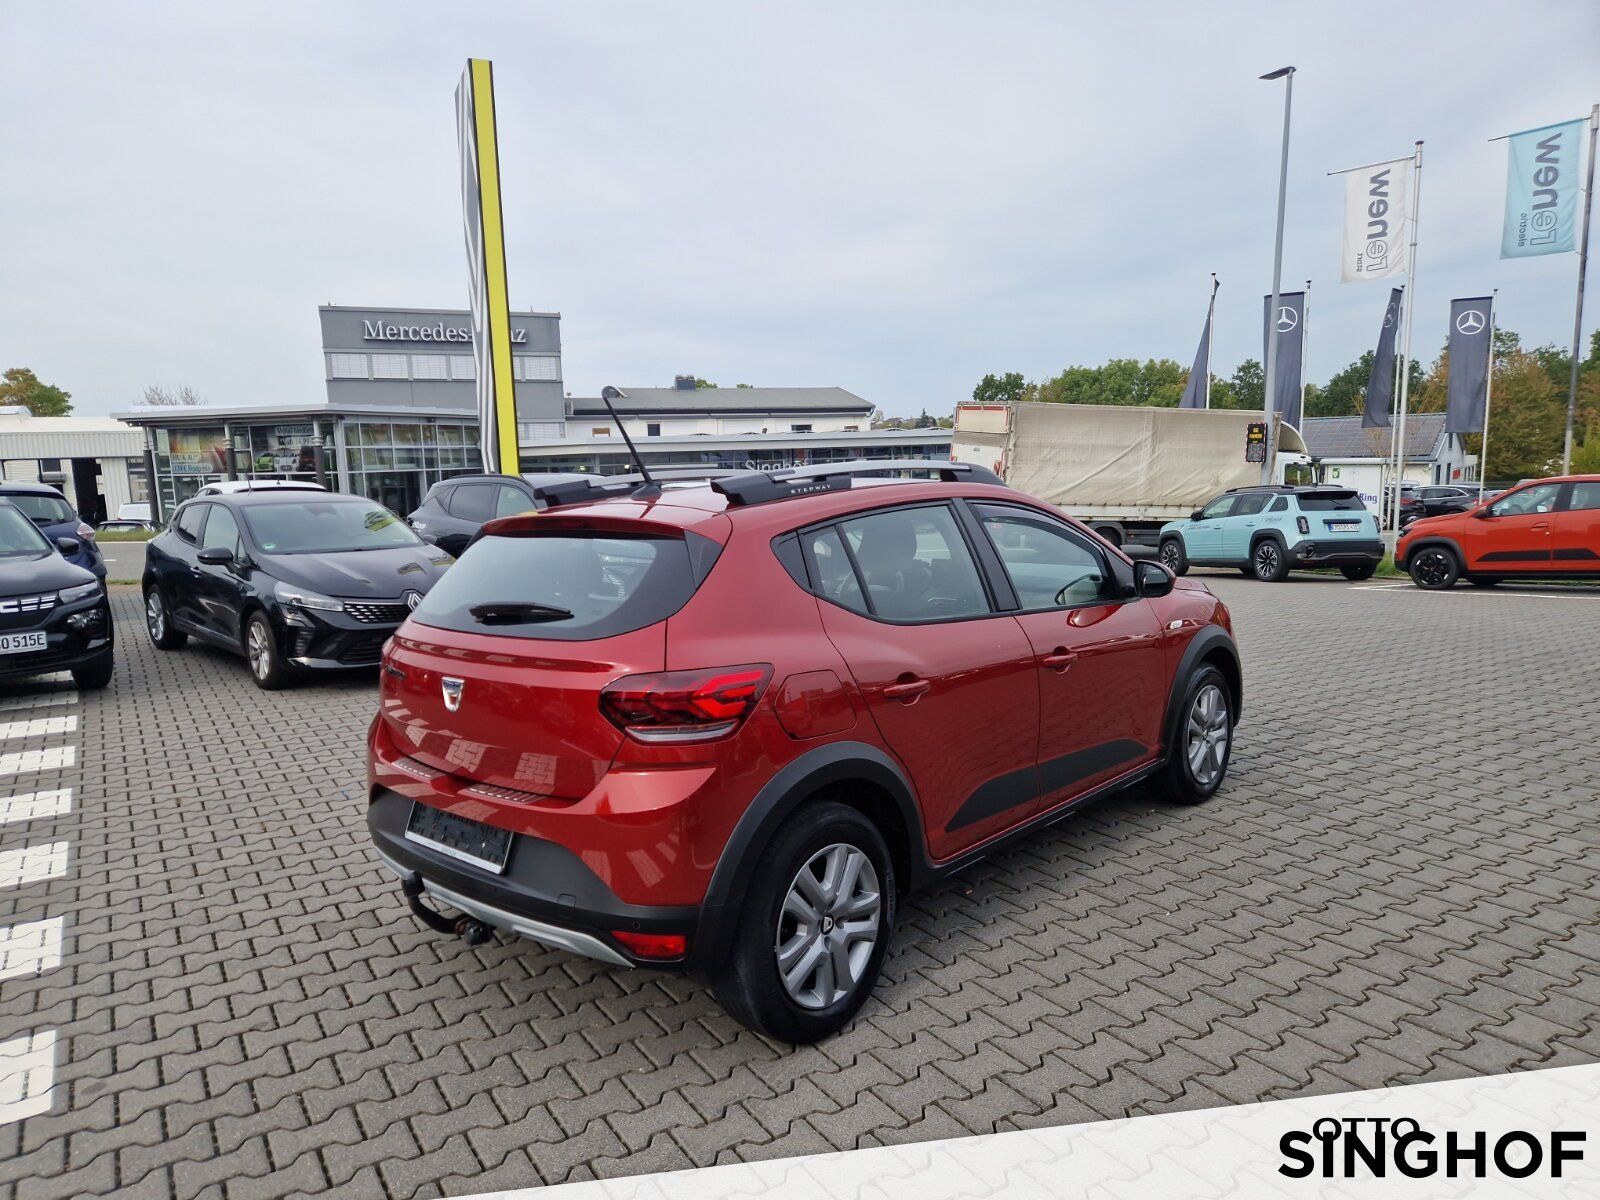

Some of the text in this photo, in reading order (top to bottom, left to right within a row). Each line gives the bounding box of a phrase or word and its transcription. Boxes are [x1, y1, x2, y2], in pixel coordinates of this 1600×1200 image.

[363, 319, 527, 343] Mercedes-z
[791, 484, 831, 494] STEPWAY
[13, 633, 45, 648] 515E
